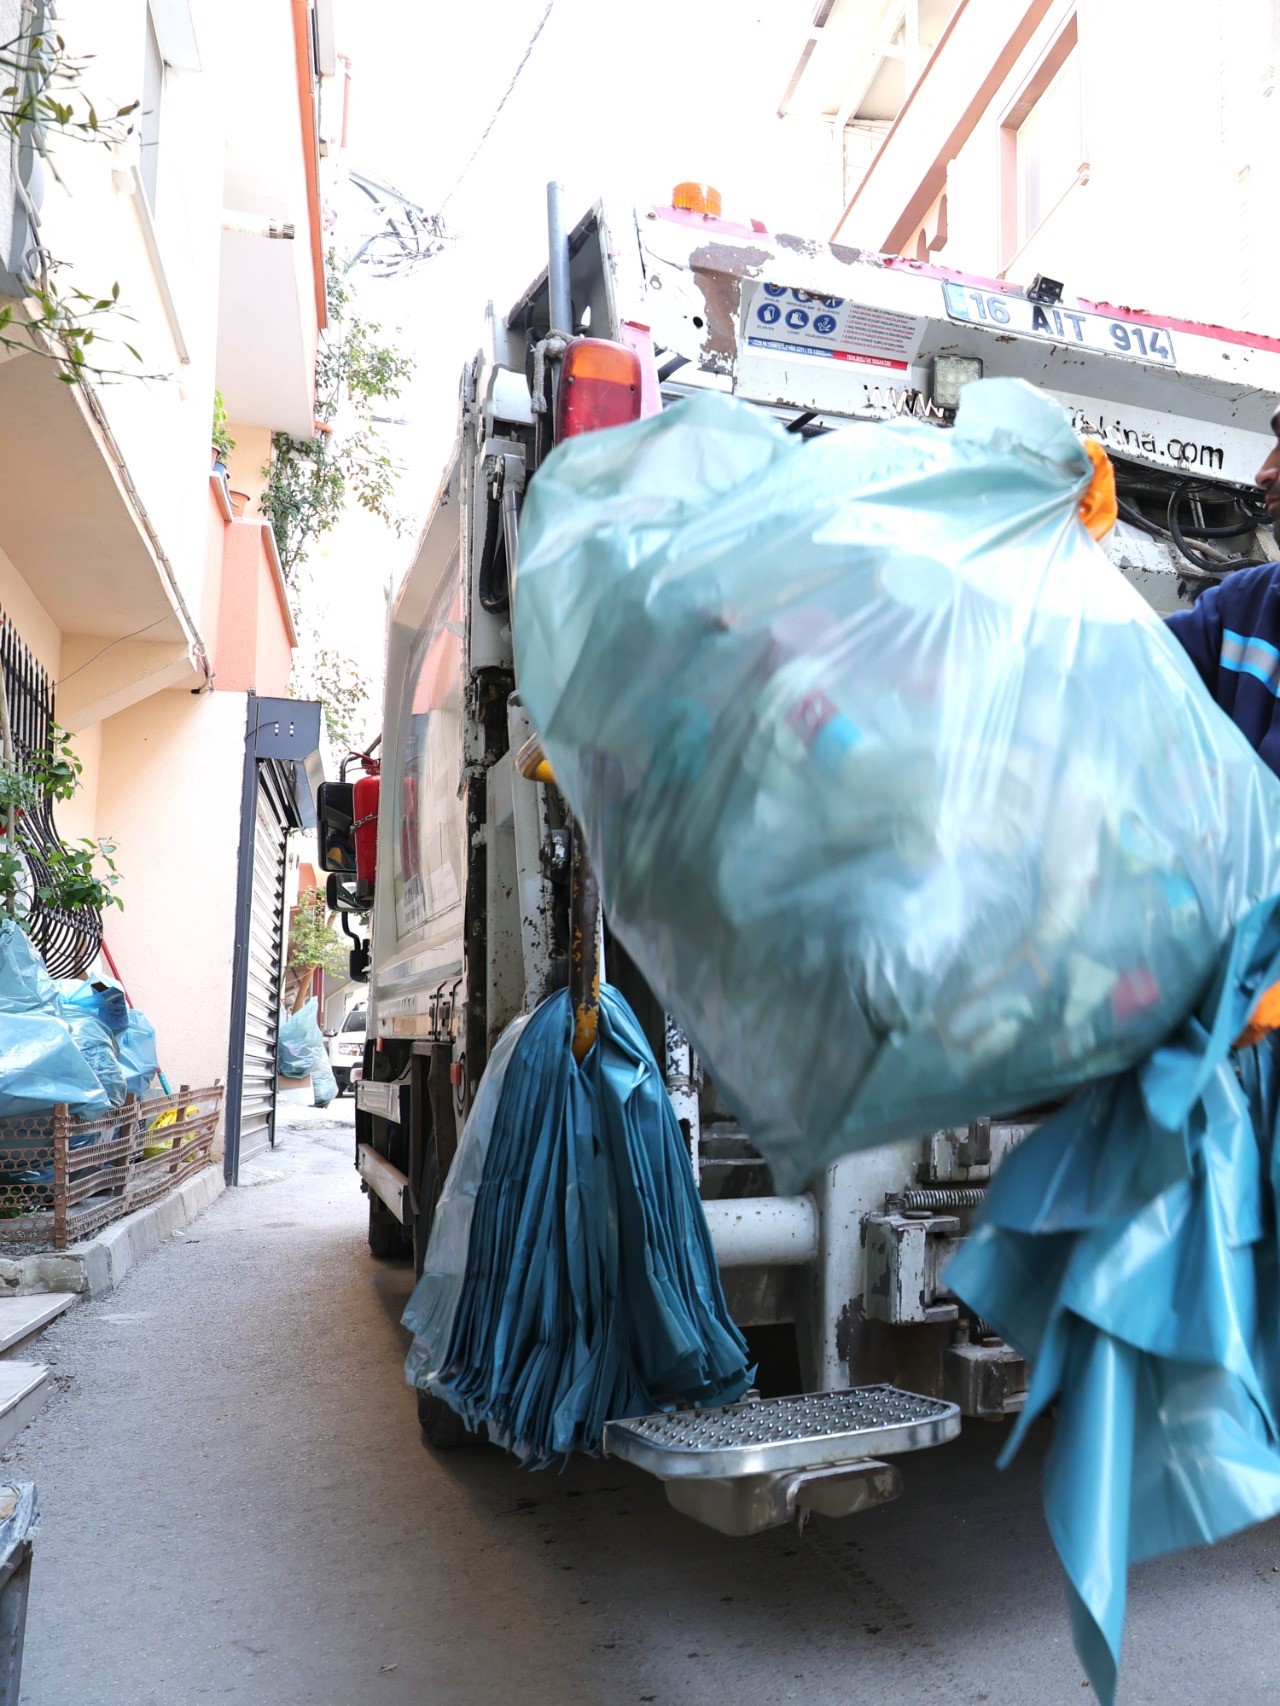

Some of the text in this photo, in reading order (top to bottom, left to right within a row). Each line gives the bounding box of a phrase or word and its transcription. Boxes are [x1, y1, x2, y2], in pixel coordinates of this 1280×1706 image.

[970, 292, 1169, 360] 16 AIT 914
